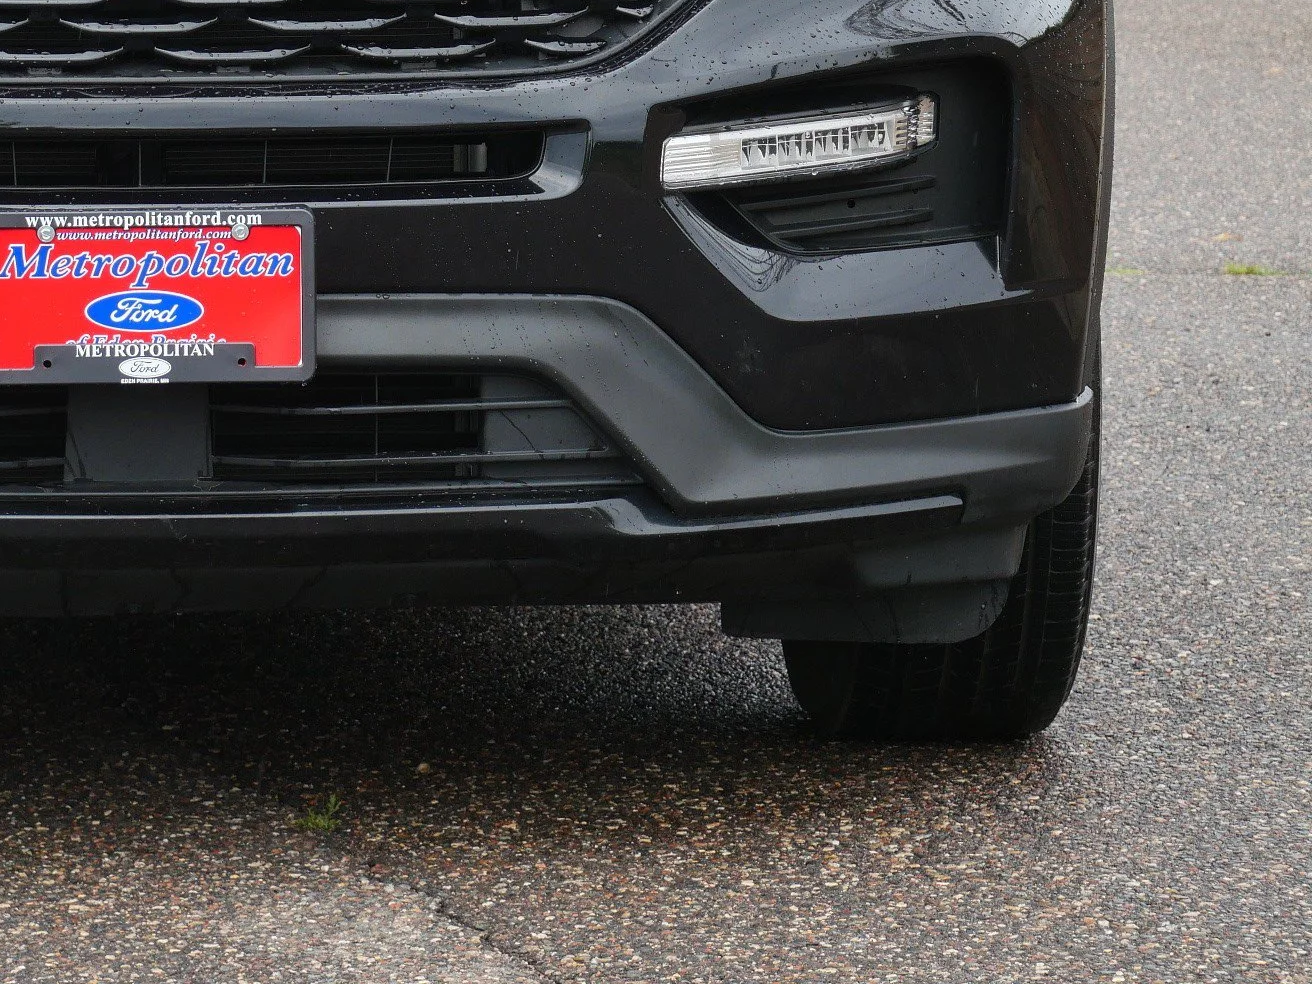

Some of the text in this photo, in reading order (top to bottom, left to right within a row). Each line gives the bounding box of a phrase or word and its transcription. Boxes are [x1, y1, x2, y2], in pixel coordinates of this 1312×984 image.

[25, 211, 263, 230] www.metropolitanford.com
[56, 228, 232, 243] www.metropolitanford.com
[110, 297, 178, 324] Ford
[75, 343, 215, 357] METROPOLITAN
[130, 360, 160, 373] Ford
